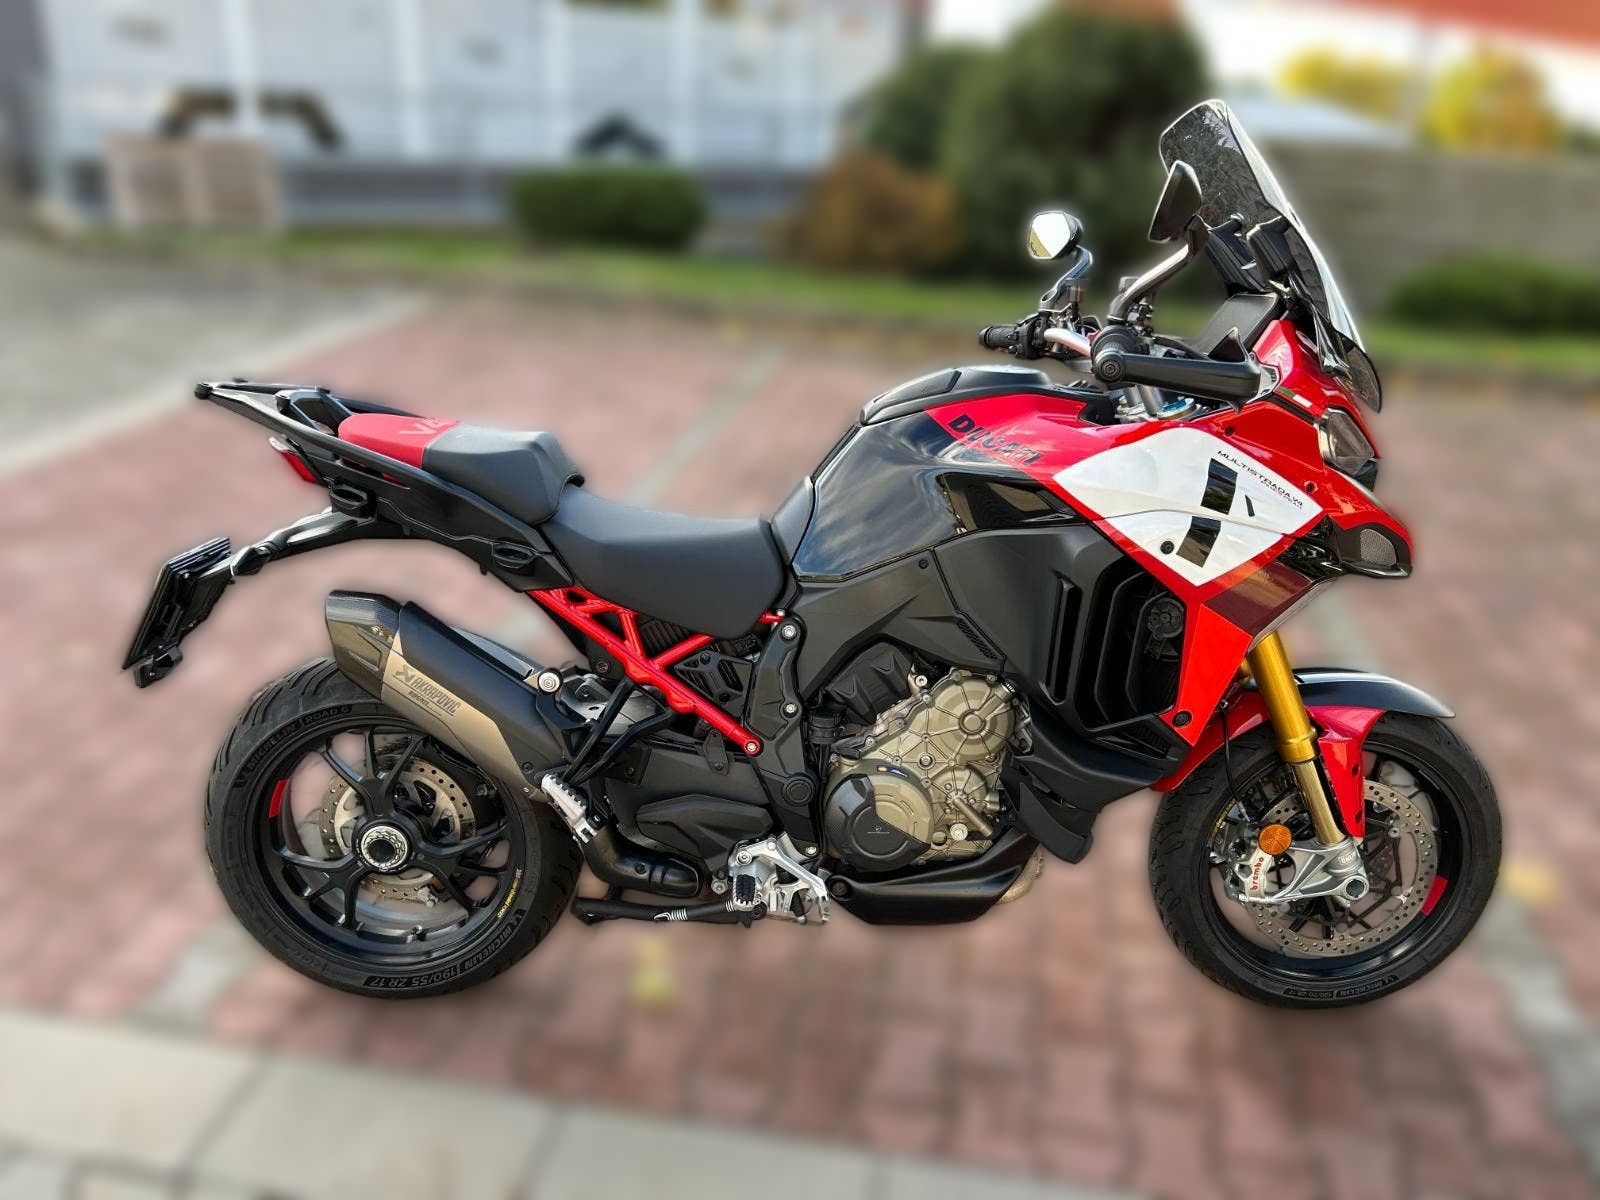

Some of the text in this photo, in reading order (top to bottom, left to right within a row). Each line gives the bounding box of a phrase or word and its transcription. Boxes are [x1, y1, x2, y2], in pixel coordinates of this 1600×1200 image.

[947, 414, 1044, 466] DUCATI
[1217, 450, 1291, 498] MULTISTRADA
[305, 707, 338, 724] ROAD
[1250, 856, 1264, 890] brembo
[369, 925, 513, 988] MICHELIN 190/55 ZR 17
